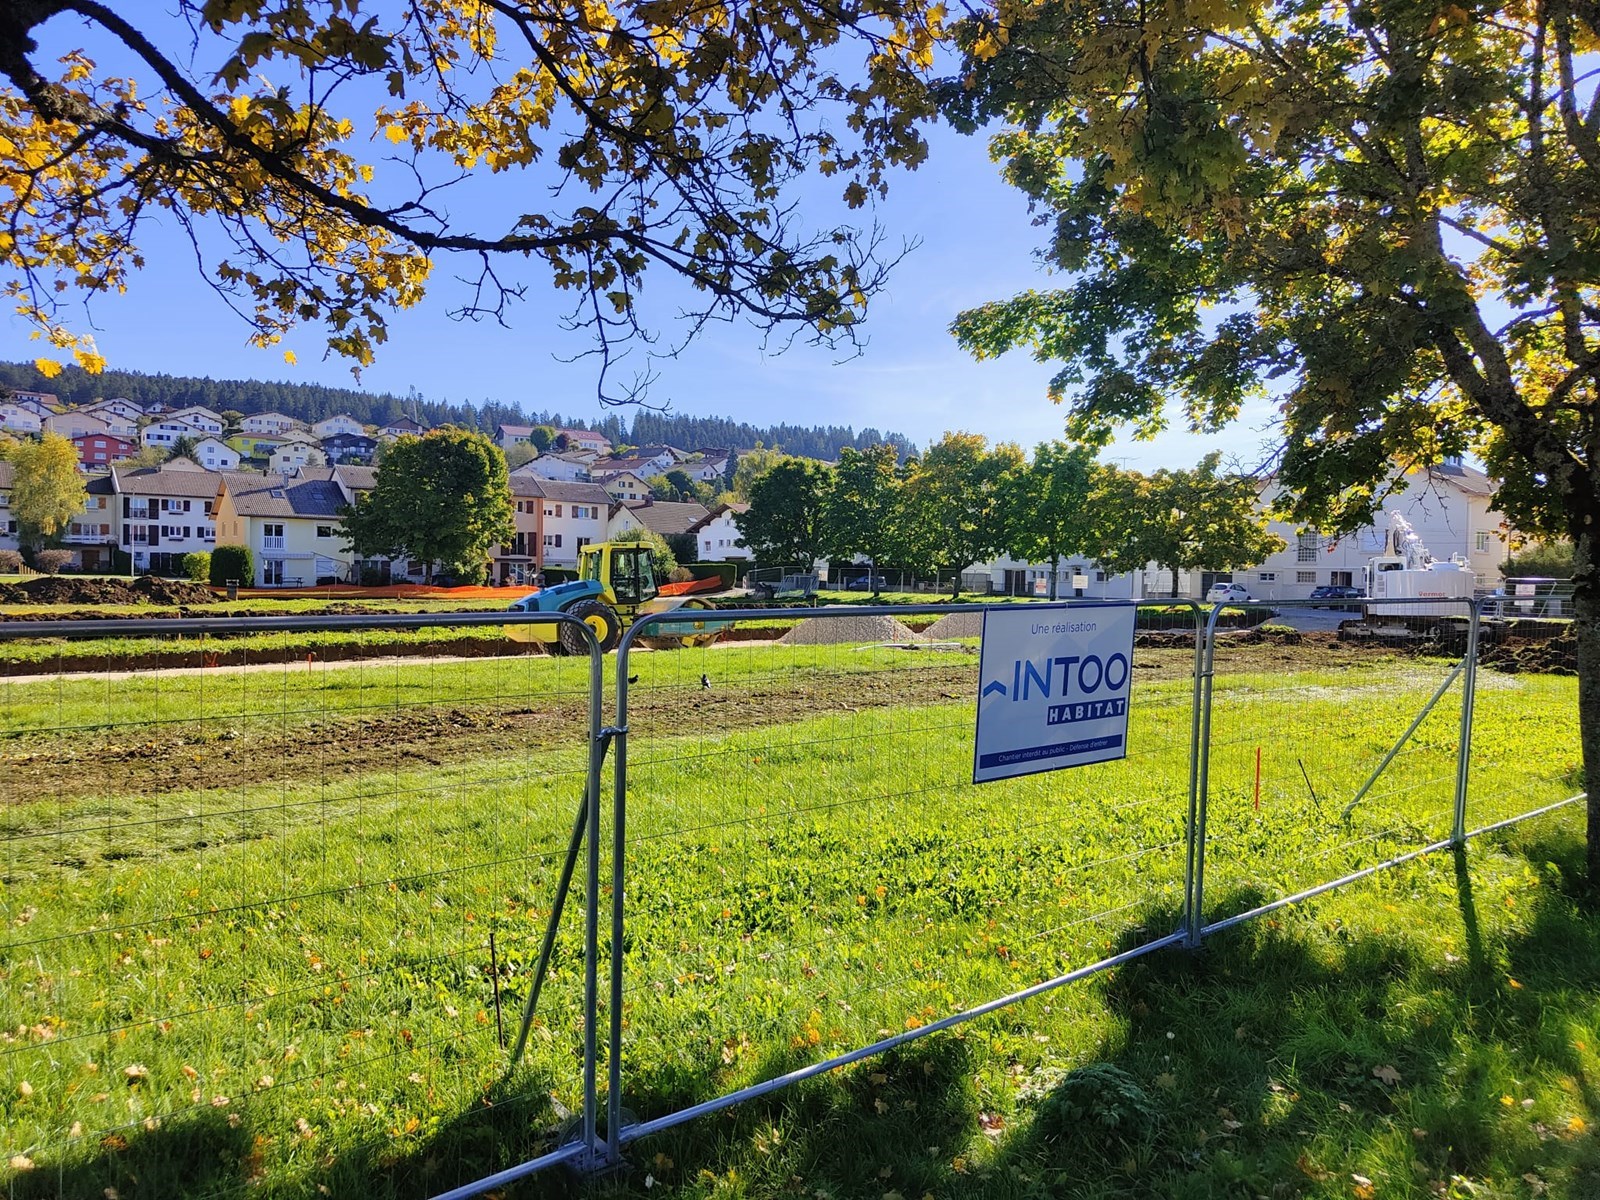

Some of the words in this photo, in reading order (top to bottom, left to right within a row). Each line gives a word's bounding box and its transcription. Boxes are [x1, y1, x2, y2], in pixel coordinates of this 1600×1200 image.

[1031, 624, 1050, 635] Une
[1052, 621, 1097, 634] réalisation
[1013, 653, 1128, 702] INTOO
[1049, 700, 1124, 723] HABITAT
[998, 753, 1022, 762] Chantier
[1022, 750, 1041, 759] interdit
[1049, 746, 1065, 756] public
